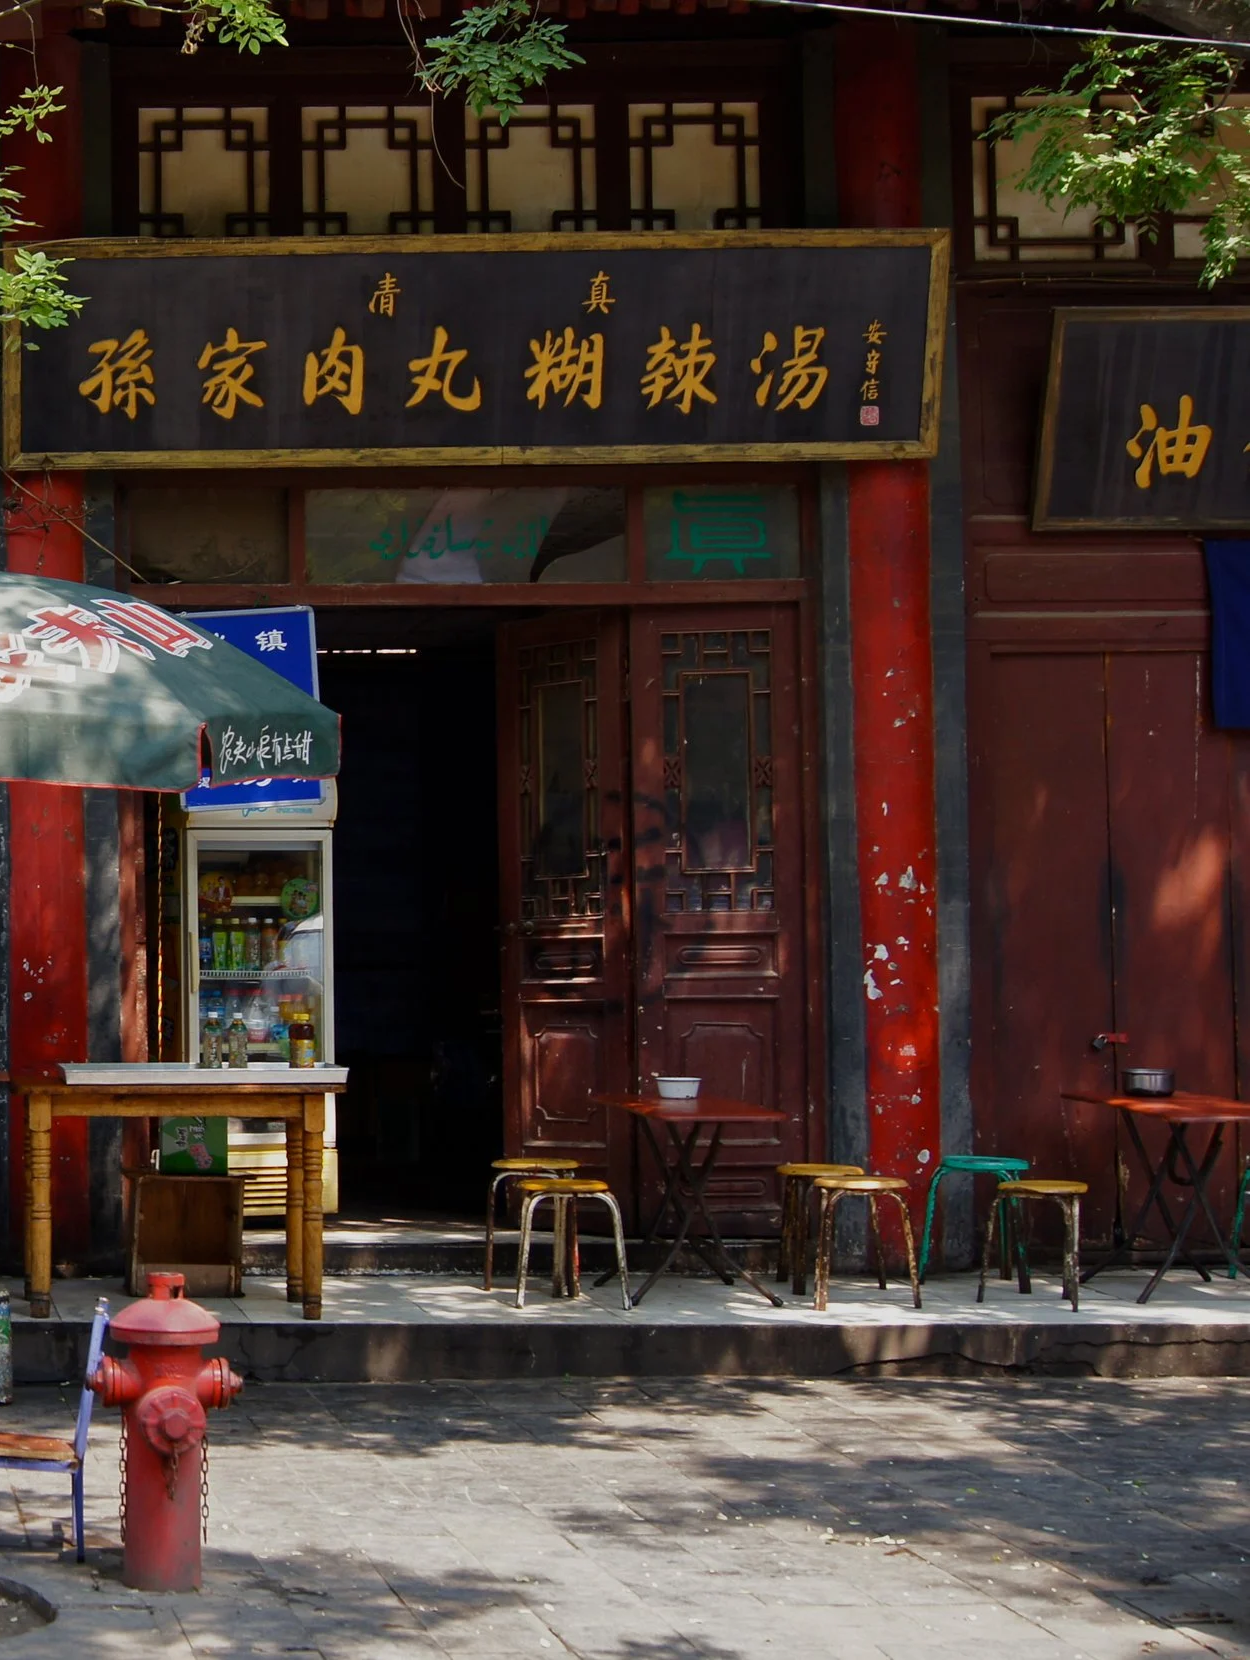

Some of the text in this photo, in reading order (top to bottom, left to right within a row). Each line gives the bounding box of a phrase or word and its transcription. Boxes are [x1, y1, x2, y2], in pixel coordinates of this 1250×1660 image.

[369, 272, 401, 317] 清
[581, 270, 616, 314] 真
[1126, 394, 1250, 489] 油
